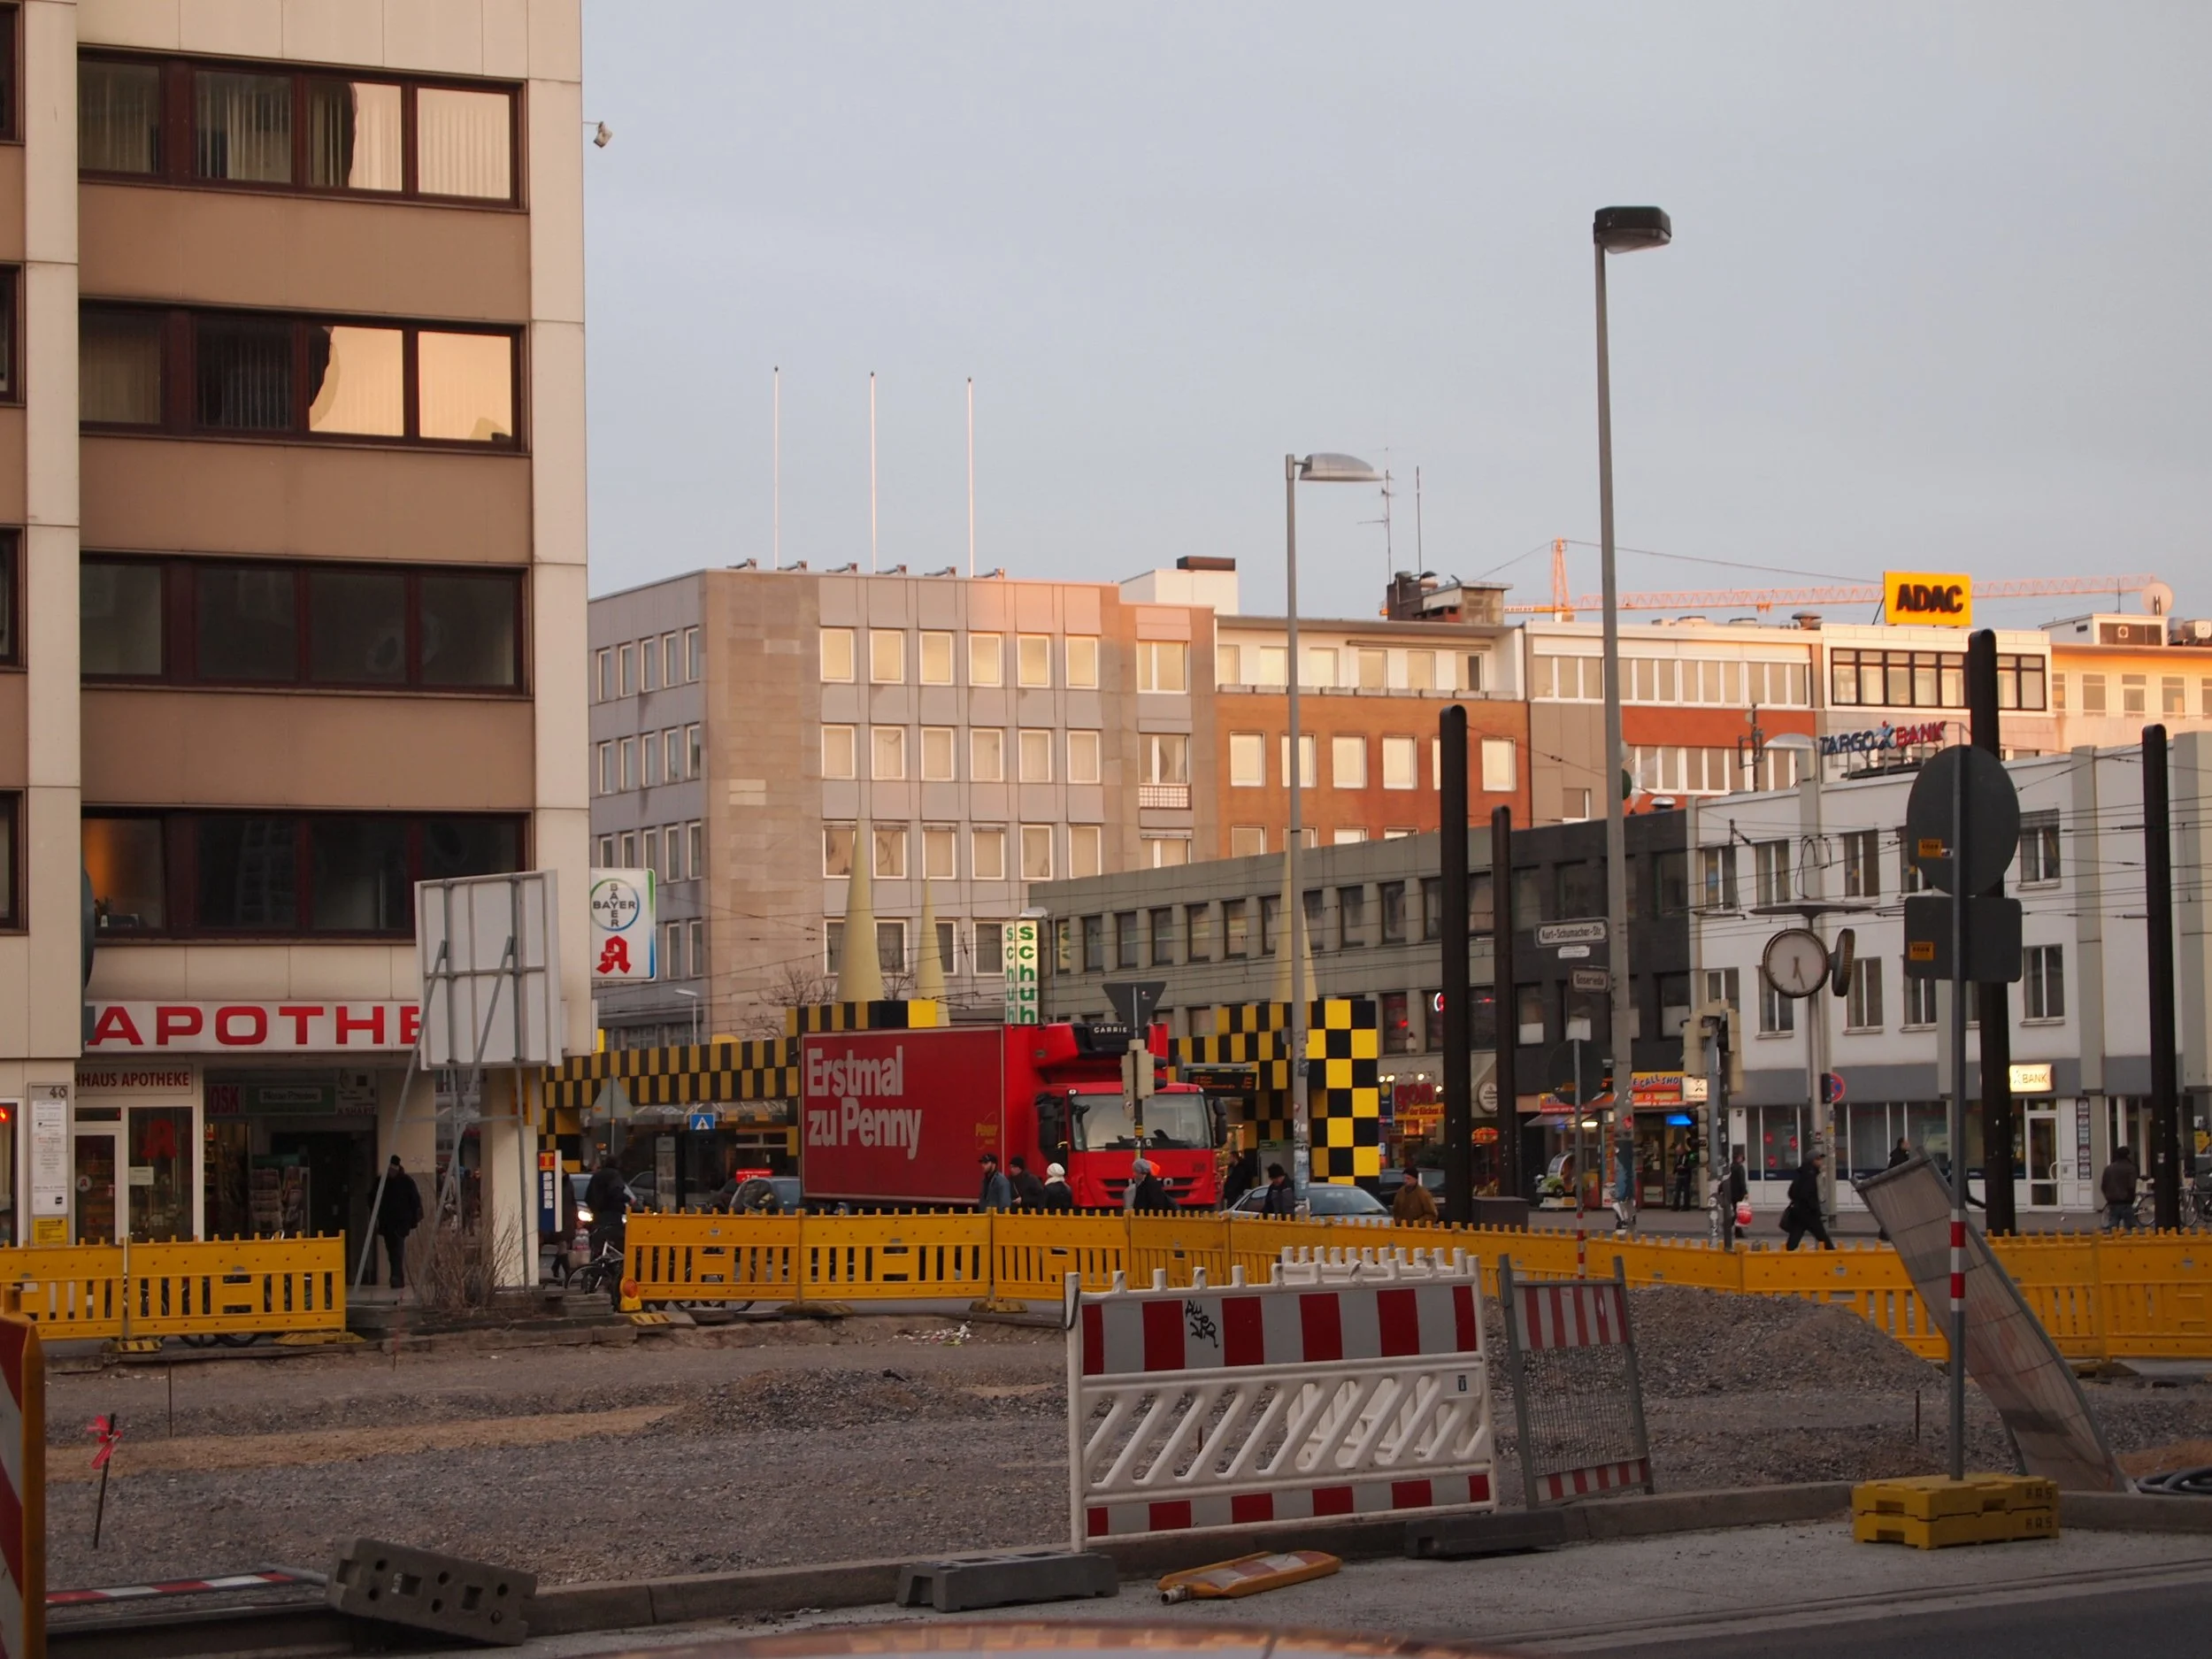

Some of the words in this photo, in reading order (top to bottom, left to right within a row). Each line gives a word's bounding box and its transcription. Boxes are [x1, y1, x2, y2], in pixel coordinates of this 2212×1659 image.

[1895, 583, 1963, 613] ADAC
[1819, 730, 1874, 756] TARGO
[1896, 721, 1947, 748] BANK
[593, 900, 636, 910] BAYER
[610, 883, 618, 927] BAYER
[1018, 926, 1035, 1024] schuh
[120, 1071, 189, 1087] APOTHEKE
[807, 1045, 903, 1097] Erstmal
[1662, 1076, 1682, 1085] SHO
[2022, 1072, 2048, 1084] BANK
[807, 1110, 837, 1147] zu
[841, 1096, 923, 1160] Penny
